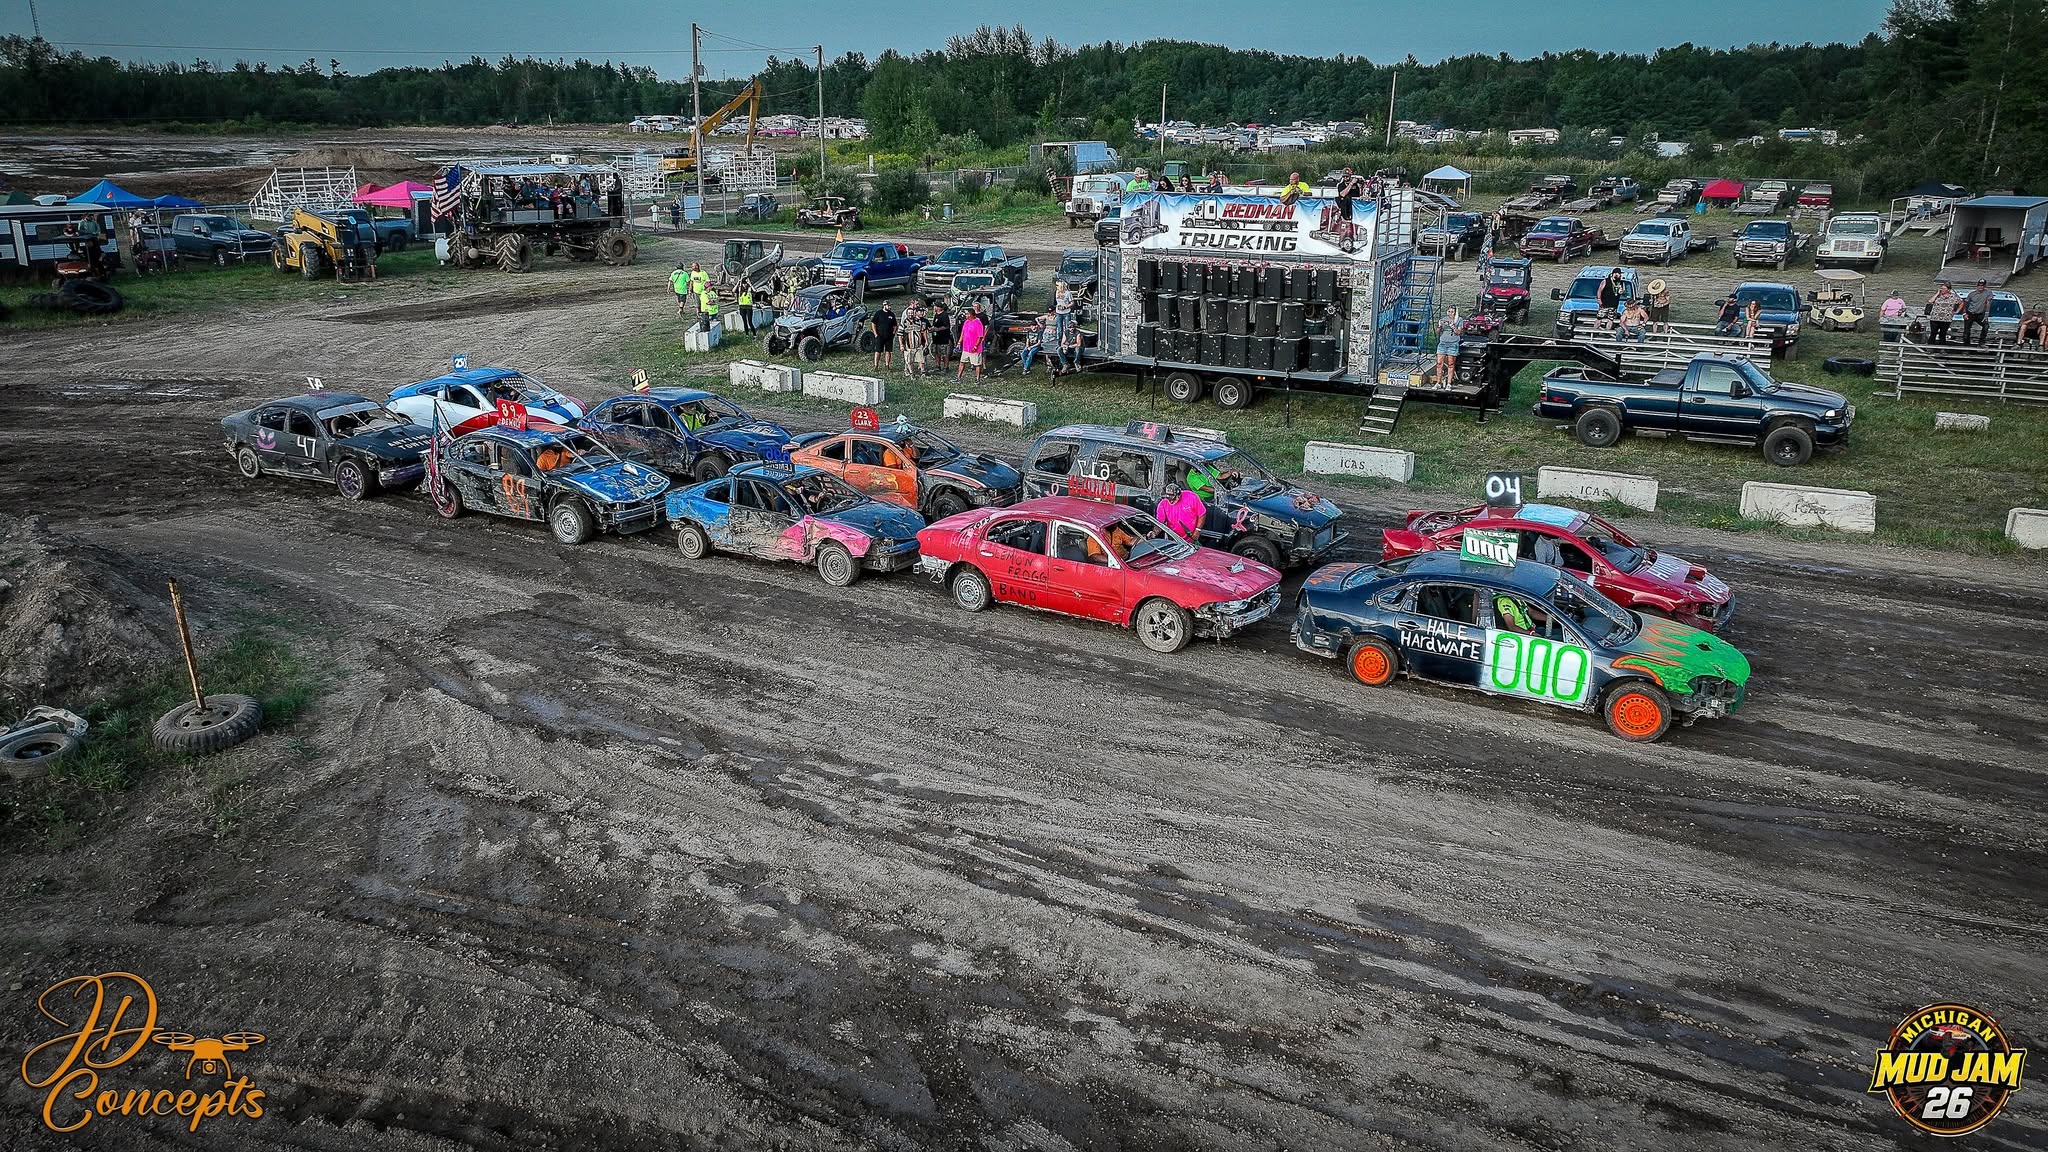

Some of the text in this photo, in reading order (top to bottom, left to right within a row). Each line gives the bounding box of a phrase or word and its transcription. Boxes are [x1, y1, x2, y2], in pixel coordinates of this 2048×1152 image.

[1222, 203, 1296, 219] REDMAN
[631, 369, 647, 386] 70
[501, 403, 516, 417] 89
[857, 411, 868, 419] 23
[854, 419, 872, 427] CLARK
[1142, 422, 1157, 440] 4
[297, 435, 317, 458] 47
[1340, 457, 1366, 470] ICAS
[501, 473, 532, 519] 89
[1486, 475, 1520, 505] 04
[1580, 485, 1609, 497] ICAS
[1466, 528, 1518, 539] STEVENSON
[995, 548, 1034, 566] LEMON
[1465, 536, 1511, 565] 000
[1008, 566, 1048, 583] FROGG
[1000, 583, 1037, 601] BAND
[1426, 618, 1469, 641] HALE
[1491, 632, 1588, 701] 000
